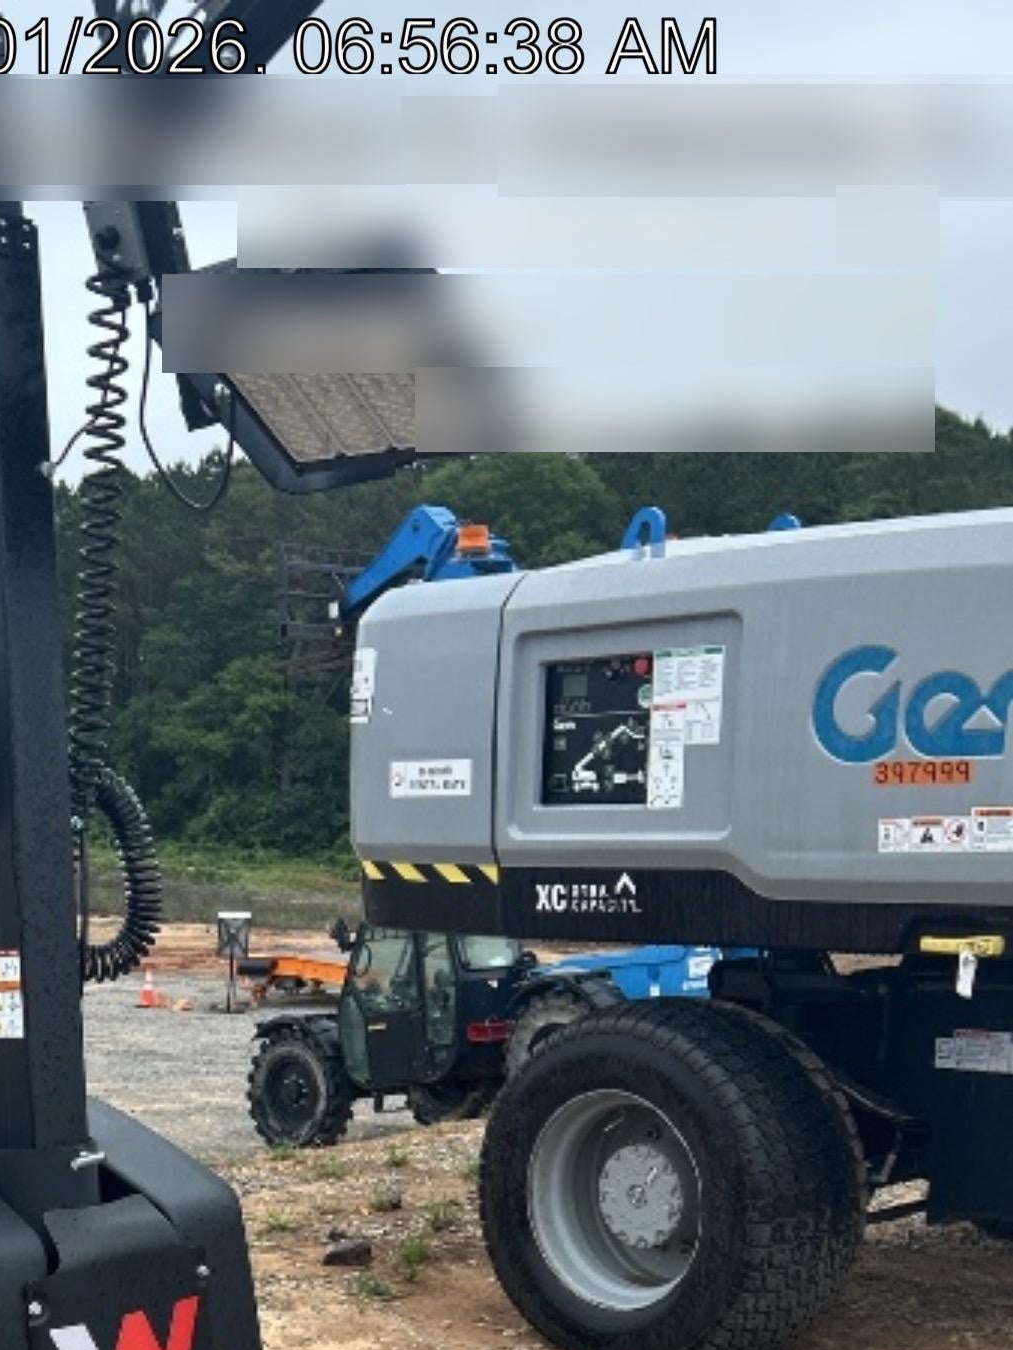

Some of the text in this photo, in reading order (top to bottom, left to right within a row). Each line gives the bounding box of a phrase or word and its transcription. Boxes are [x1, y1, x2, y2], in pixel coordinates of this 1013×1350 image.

[812, 645, 1013, 764] Ge
[874, 762, 971, 784] 397999
[535, 884, 568, 912] XC
